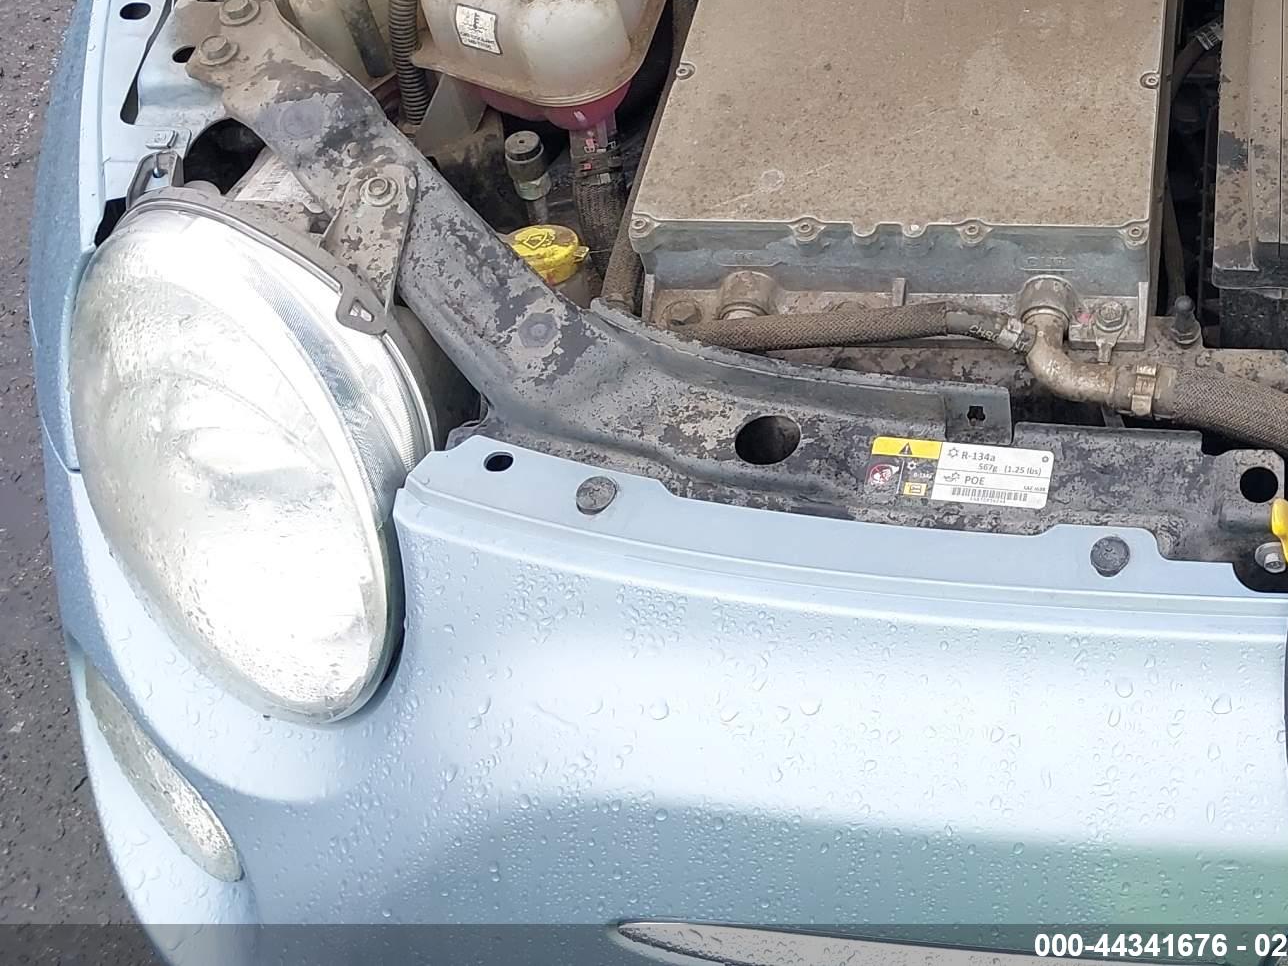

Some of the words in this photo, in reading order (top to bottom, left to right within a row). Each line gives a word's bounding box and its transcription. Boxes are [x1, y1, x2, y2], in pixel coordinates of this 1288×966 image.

[961, 450, 996, 462] R-134a
[978, 462, 998, 473] 567g
[964, 475, 985, 486] POE
